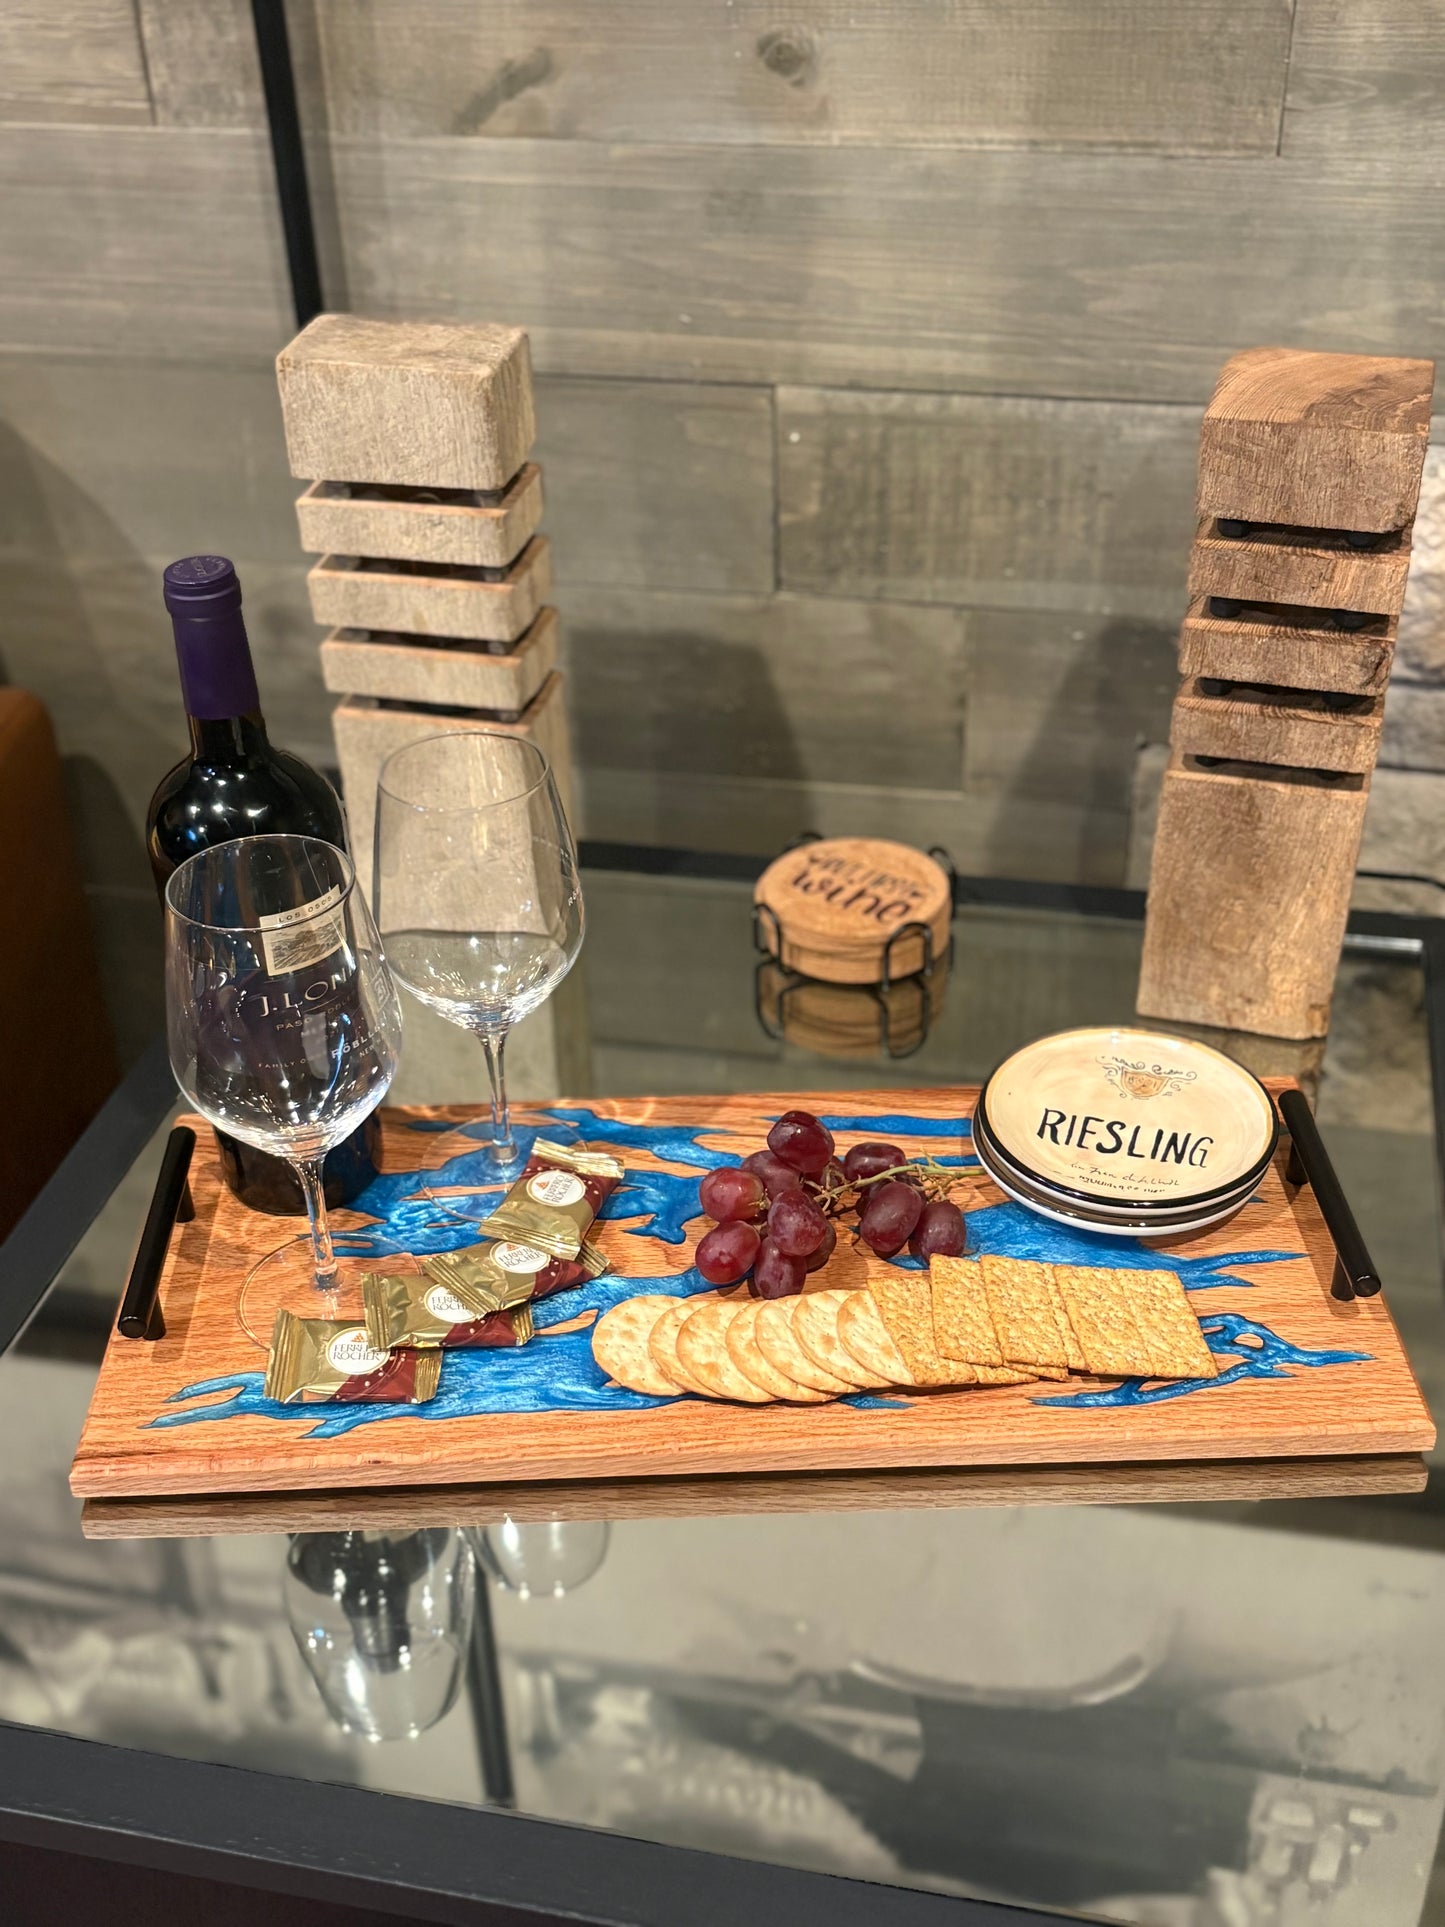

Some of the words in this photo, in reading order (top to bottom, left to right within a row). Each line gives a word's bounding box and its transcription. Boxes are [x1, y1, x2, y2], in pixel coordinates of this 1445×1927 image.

[278, 911, 301, 923] LOS
[1037, 1108, 1214, 1168] RIESLING
[543, 1174, 565, 1202] FERRERO
[551, 1177, 576, 1203] ROCHER
[498, 1247, 535, 1262] FERRER
[504, 1251, 545, 1268] ROCHER
[431, 1295, 460, 1304] FERR
[432, 1302, 468, 1311] ROCH
[334, 1343, 370, 1352] FERRE
[333, 1350, 381, 1361] ROCHER
